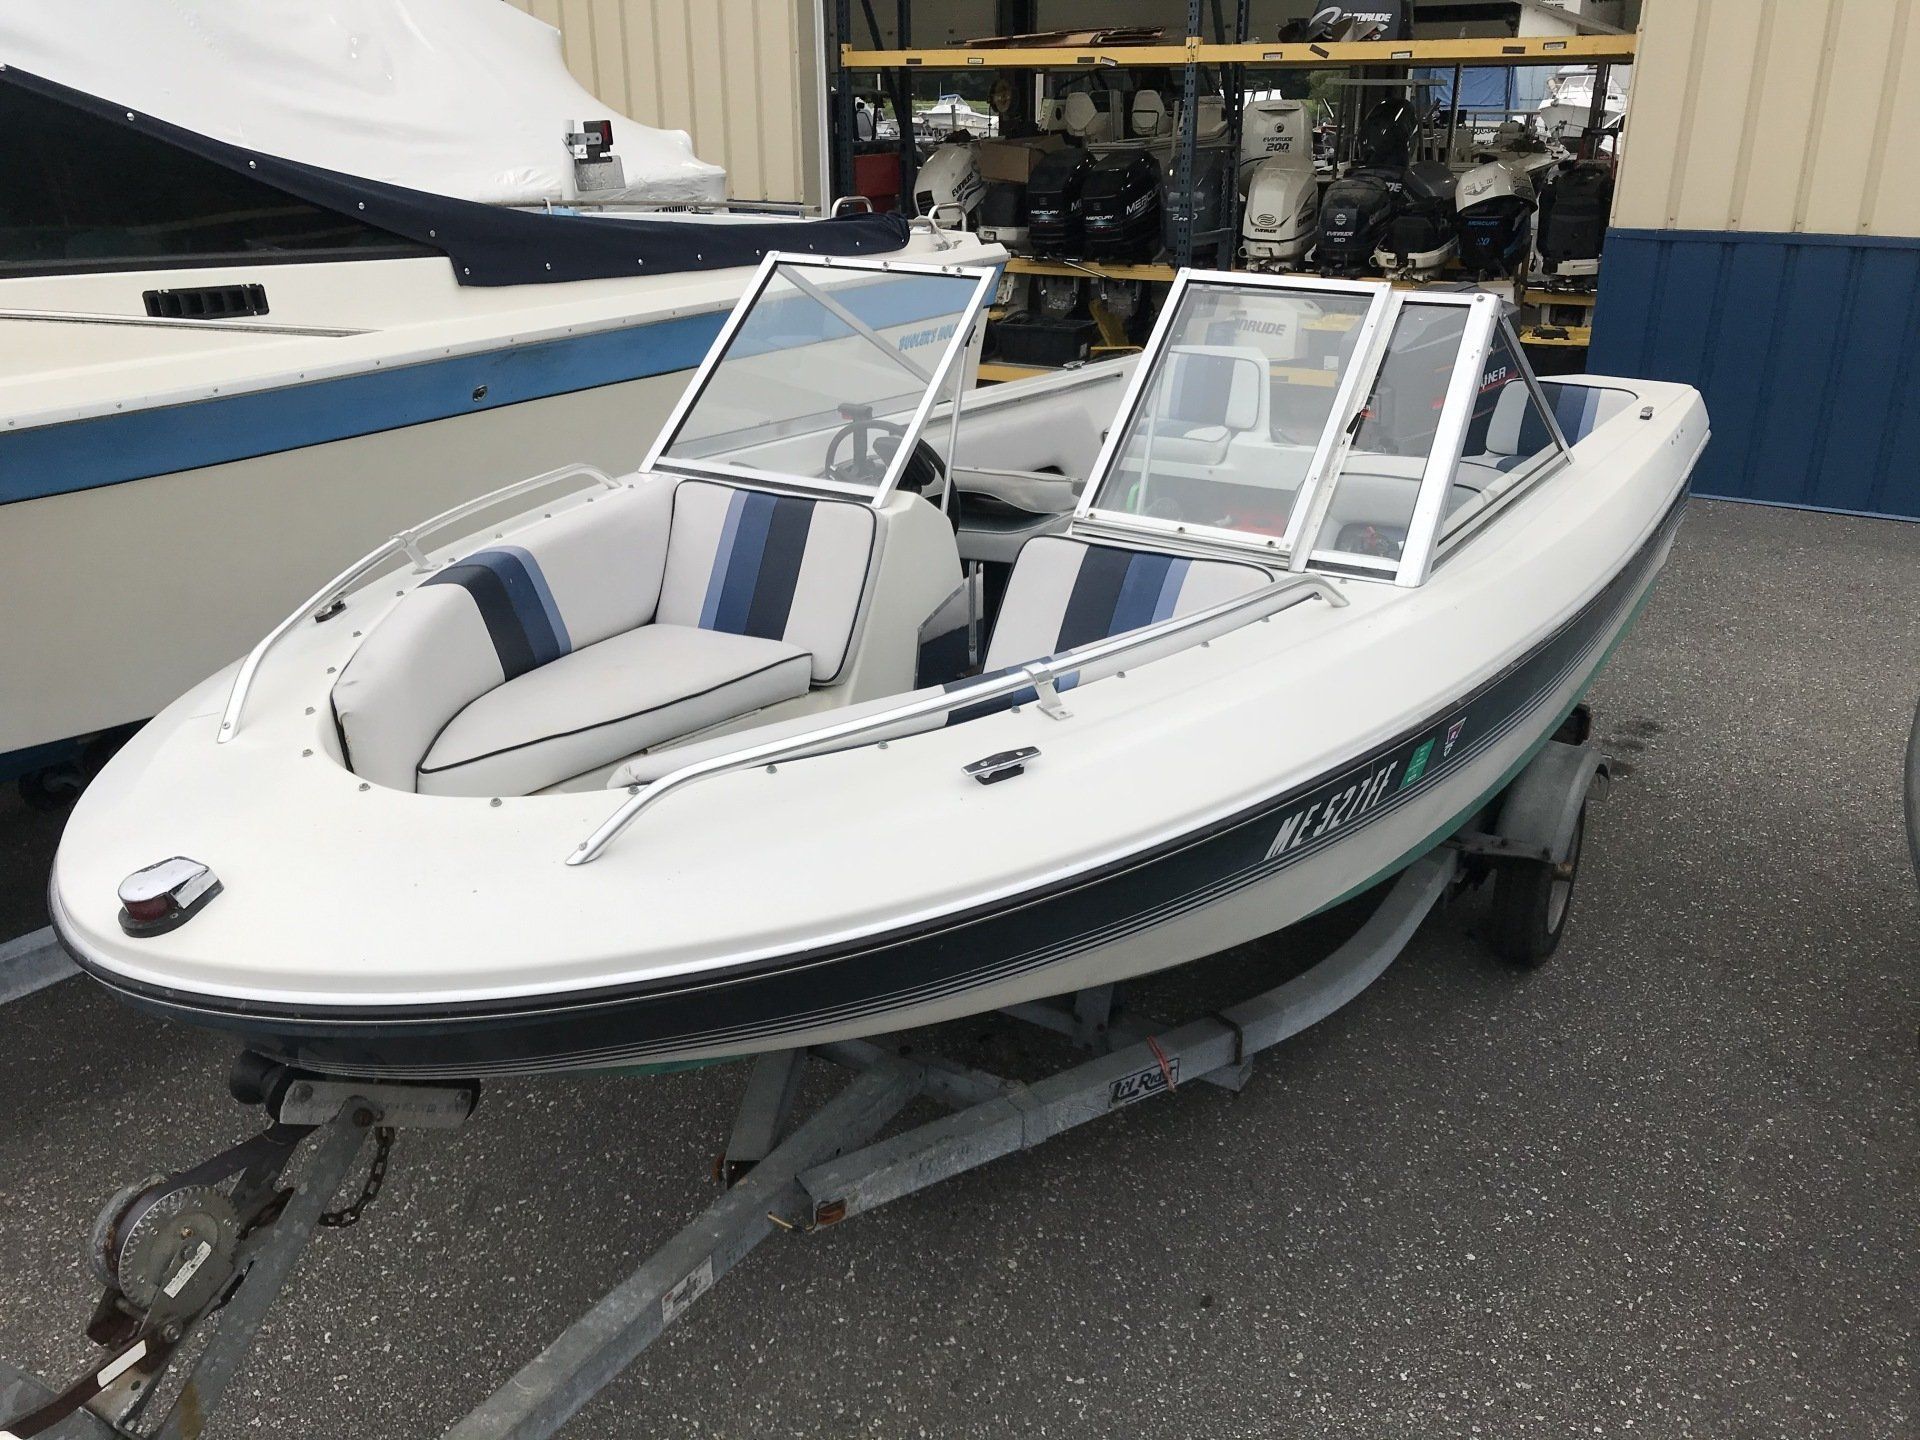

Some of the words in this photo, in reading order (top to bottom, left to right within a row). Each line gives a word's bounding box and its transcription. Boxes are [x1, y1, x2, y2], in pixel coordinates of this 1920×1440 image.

[1265, 142, 1290, 151] 200
[952, 171, 975, 197] EVINRUDE
[1263, 801, 1322, 861] ME
[1137, 1066, 1177, 1091] Ridr
